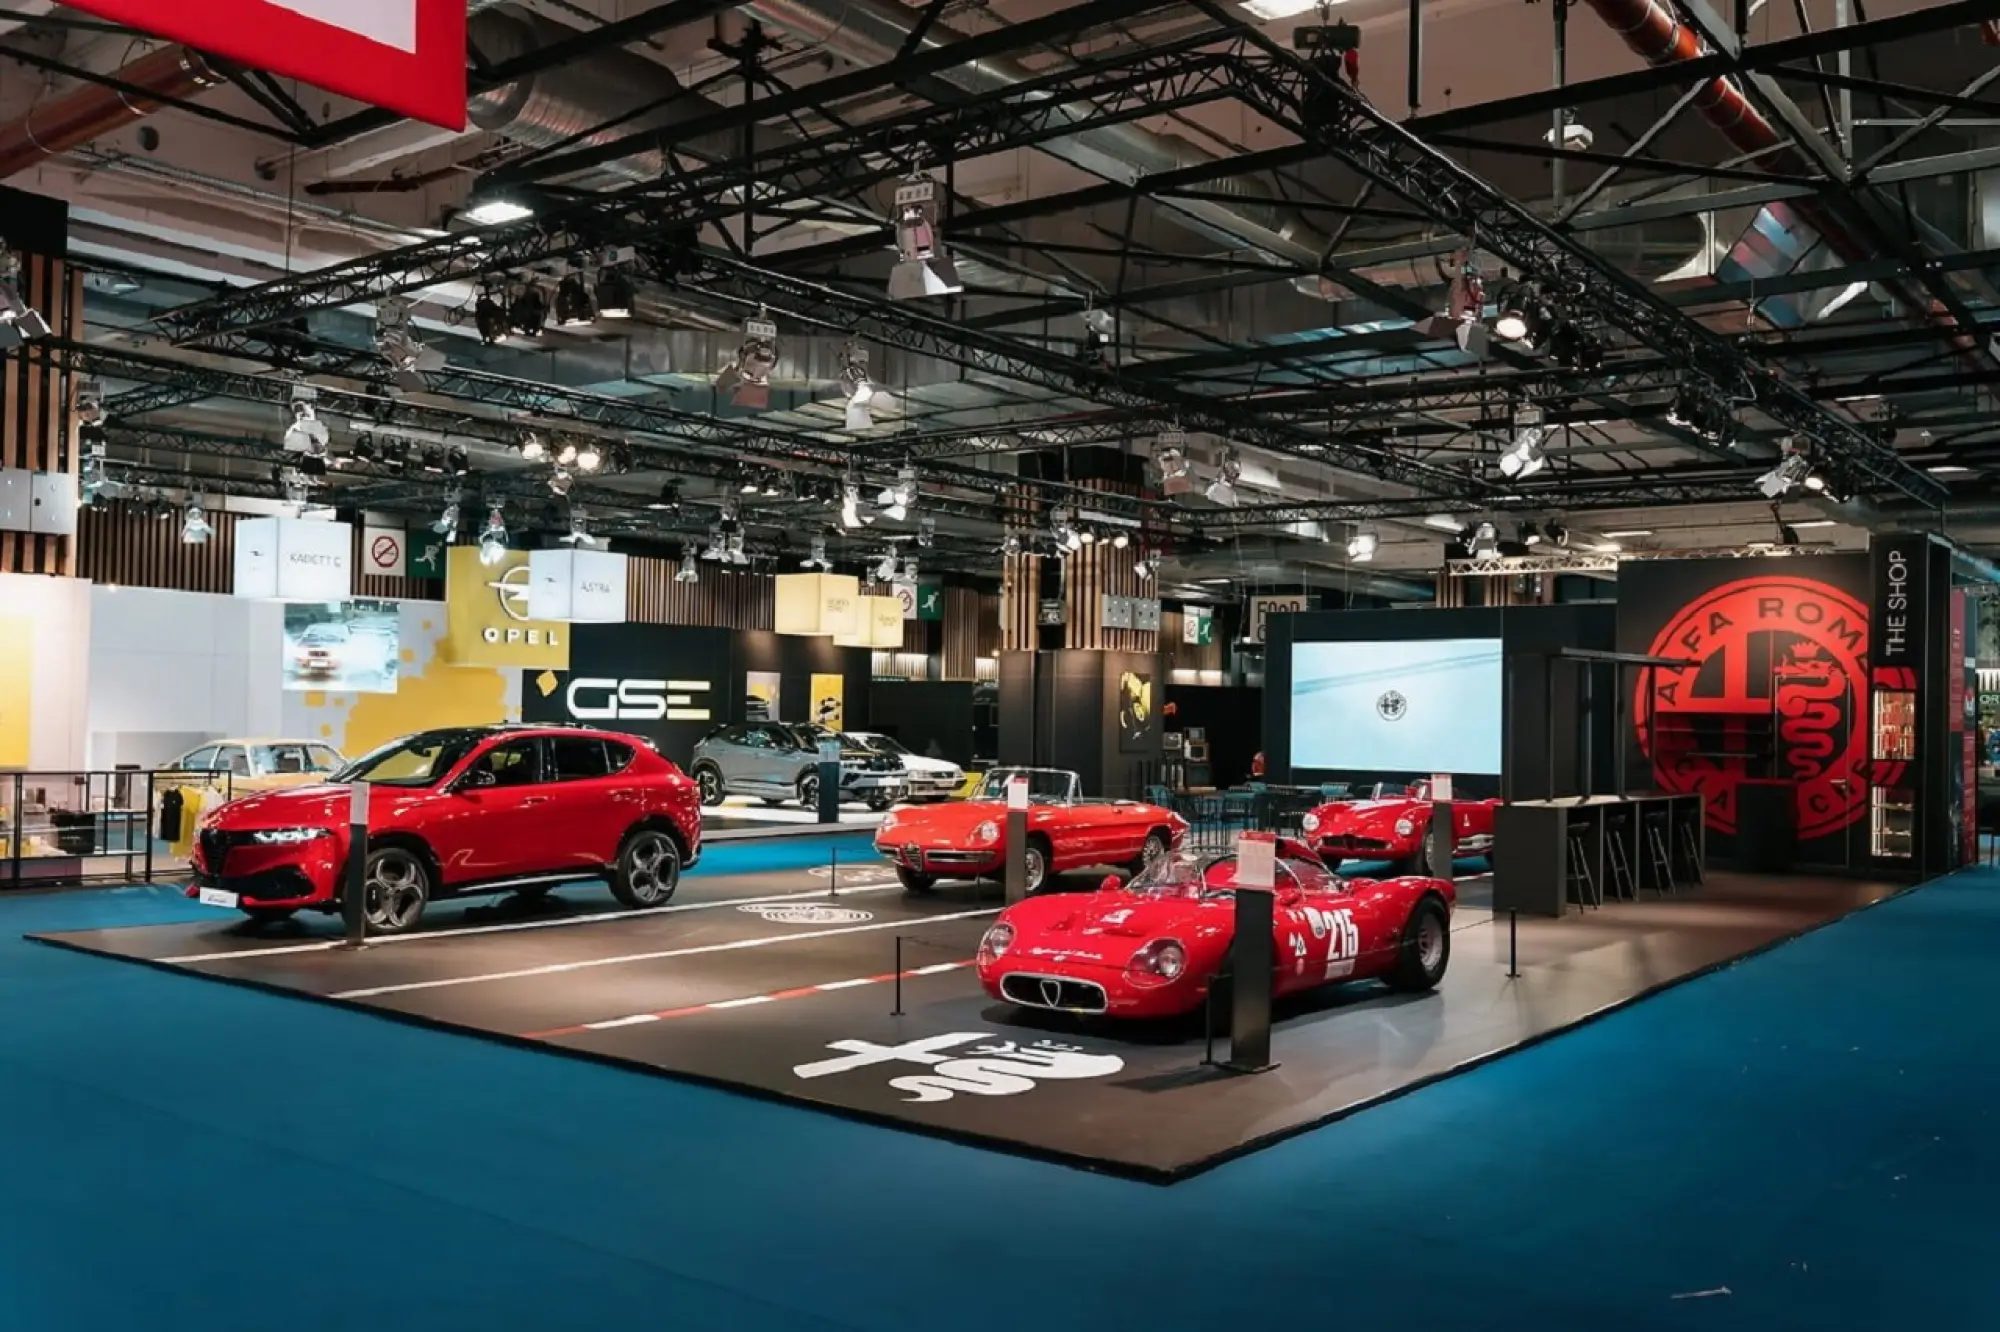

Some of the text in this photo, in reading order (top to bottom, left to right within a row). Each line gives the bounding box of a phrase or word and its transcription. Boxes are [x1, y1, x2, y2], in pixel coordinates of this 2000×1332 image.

[1885, 550, 1907, 656] THE SHOP
[482, 627, 560, 647] OPEL
[1757, 597, 1876, 684] ROM
[566, 678, 711, 720] GSE
[1322, 908, 1359, 961] 215
